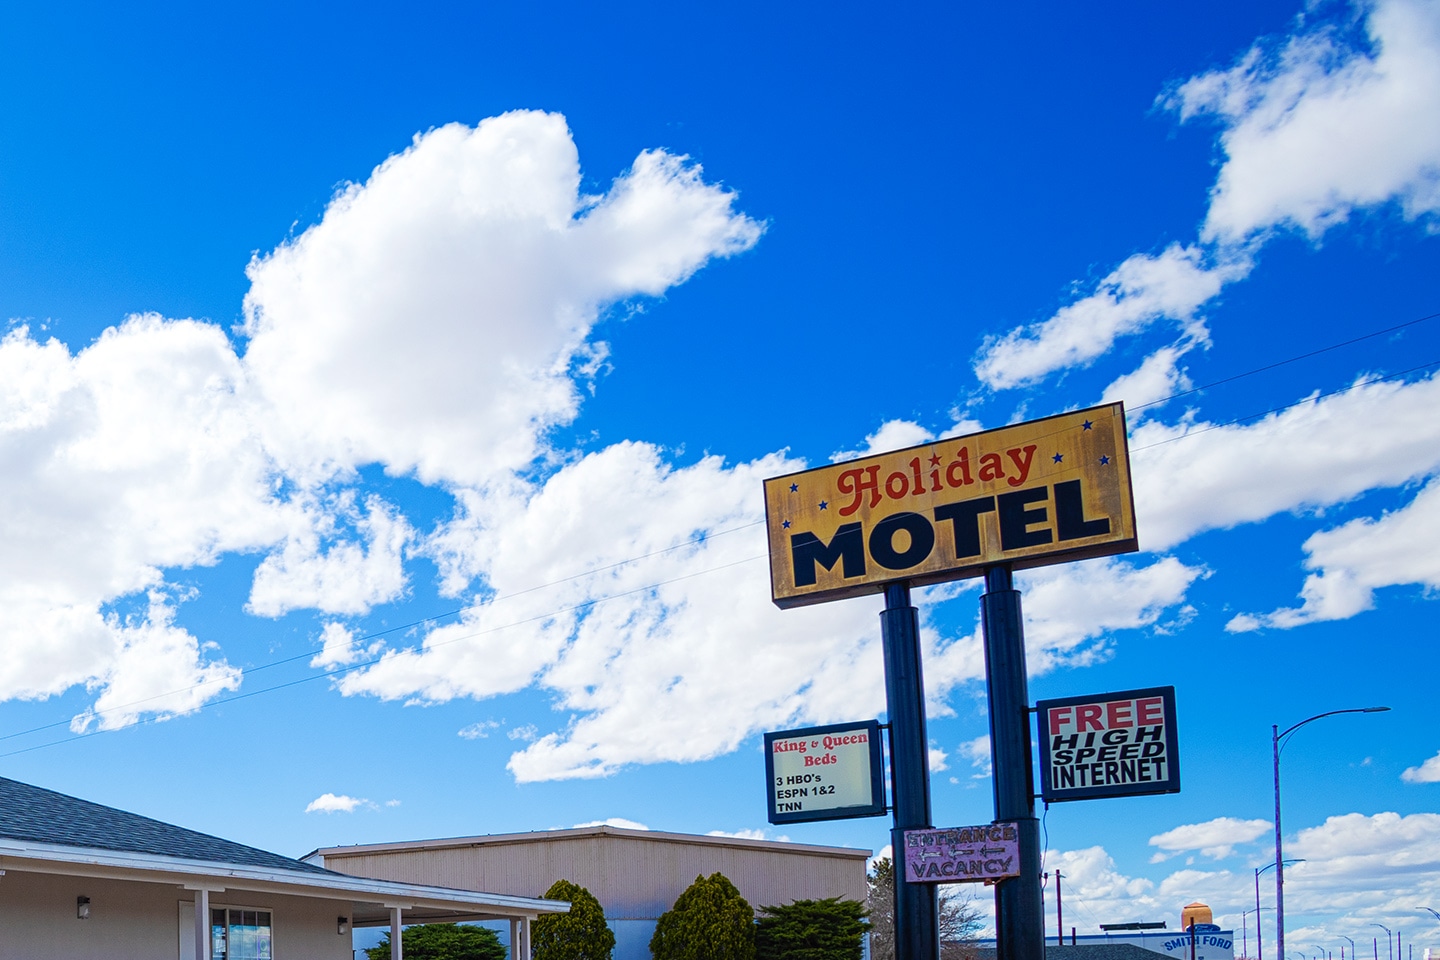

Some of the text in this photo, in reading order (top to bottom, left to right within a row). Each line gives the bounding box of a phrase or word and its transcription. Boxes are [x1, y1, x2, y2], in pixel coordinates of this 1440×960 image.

[837, 445, 1037, 516] Holiday
[790, 479, 1110, 587] MOTEL
[1049, 697, 1163, 735] FREE
[773, 740, 807, 753] King
[822, 733, 868, 750] Queen
[1052, 725, 1163, 751] HIGH
[804, 753, 837, 767] Beds
[1053, 741, 1165, 766] SPEED
[776, 774, 821, 786] 3 HBO's
[1052, 756, 1166, 789] INTERNET
[777, 785, 835, 799] ESPN 1&2
[777, 801, 802, 812] TNN
[907, 826, 1017, 848] ENTRANCE
[912, 856, 1013, 878] VACANCY
[1164, 935, 1233, 951] SMITH FORD
